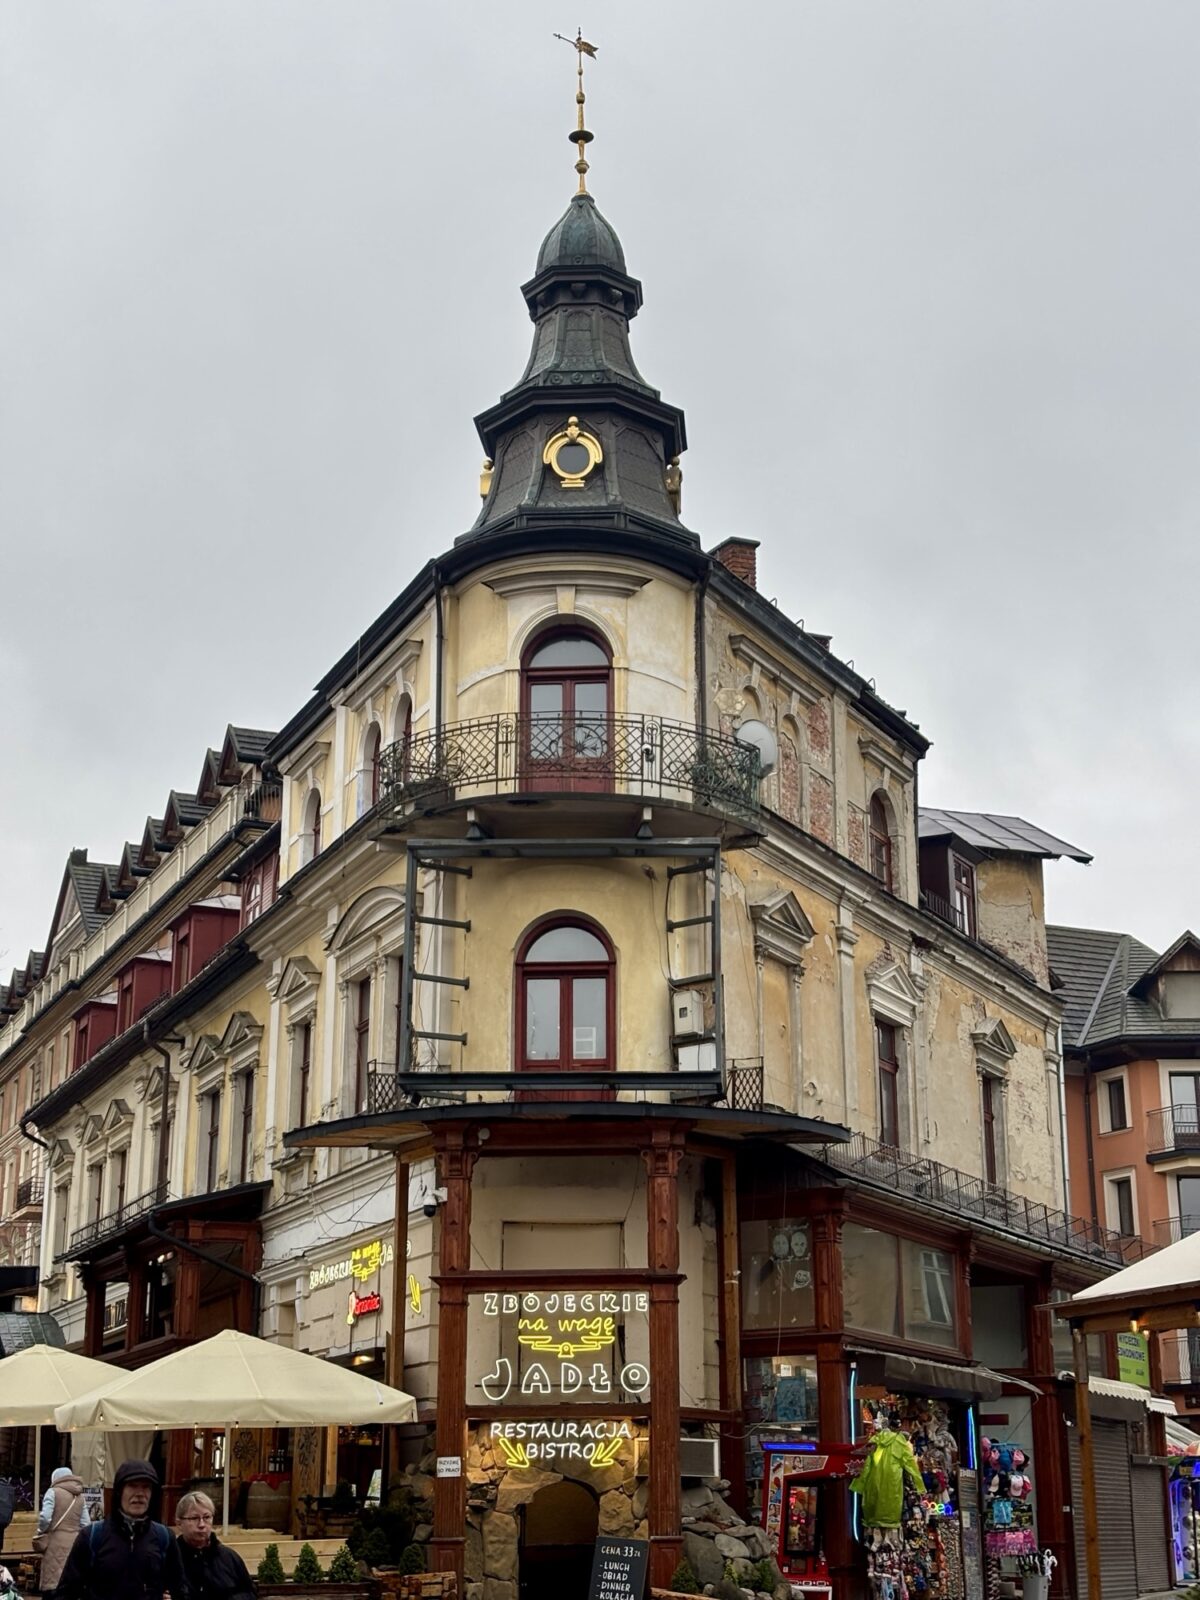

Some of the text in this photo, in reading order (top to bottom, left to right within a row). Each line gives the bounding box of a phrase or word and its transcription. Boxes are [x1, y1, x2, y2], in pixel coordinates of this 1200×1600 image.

[484, 1293, 649, 1316] ZBÓJECKIE
[518, 1316, 616, 1337] na wagę
[481, 1358, 650, 1401] JADŁO
[490, 1422, 632, 1439] RESTAURACJA
[526, 1442, 596, 1459] BISTRO
[601, 1545, 621, 1556] CENA
